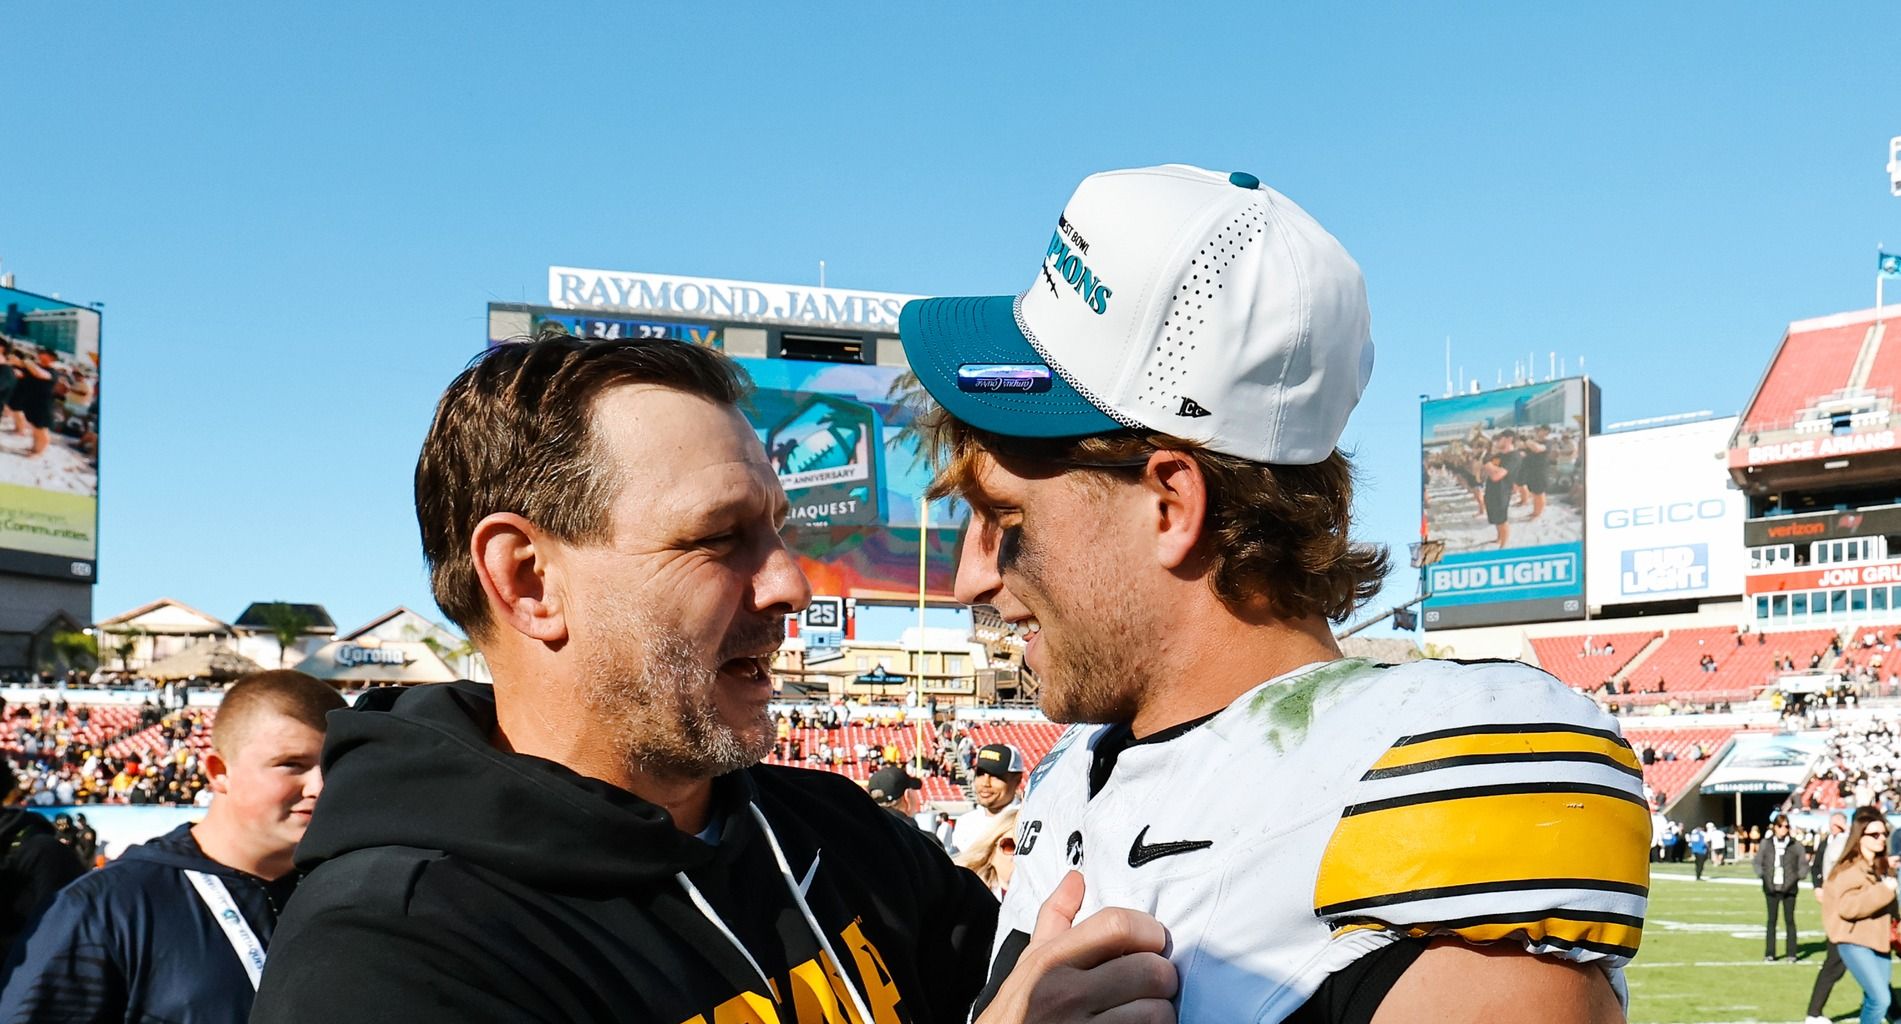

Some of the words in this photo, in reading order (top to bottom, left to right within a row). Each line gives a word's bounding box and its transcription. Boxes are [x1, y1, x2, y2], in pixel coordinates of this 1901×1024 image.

[1071, 231, 1090, 257] BOWL
[557, 272, 769, 319] RAYMOND
[773, 290, 901, 327] JAMES
[593, 321, 620, 341] 34
[1748, 440, 1815, 465] BRUCE
[1819, 430, 1895, 455] ARIANS
[794, 468, 856, 484] ANNIVERSARY
[1604, 499, 1726, 529] GEICO
[1768, 521, 1825, 538] verizon
[1633, 545, 1695, 571] BUD
[1434, 567, 1489, 591] BUD
[1491, 558, 1571, 586] LIGHT
[1622, 565, 1707, 595] LIGHT
[1818, 569, 1859, 587] JON
[808, 603, 836, 625] 25
[334, 644, 404, 667] Corona
